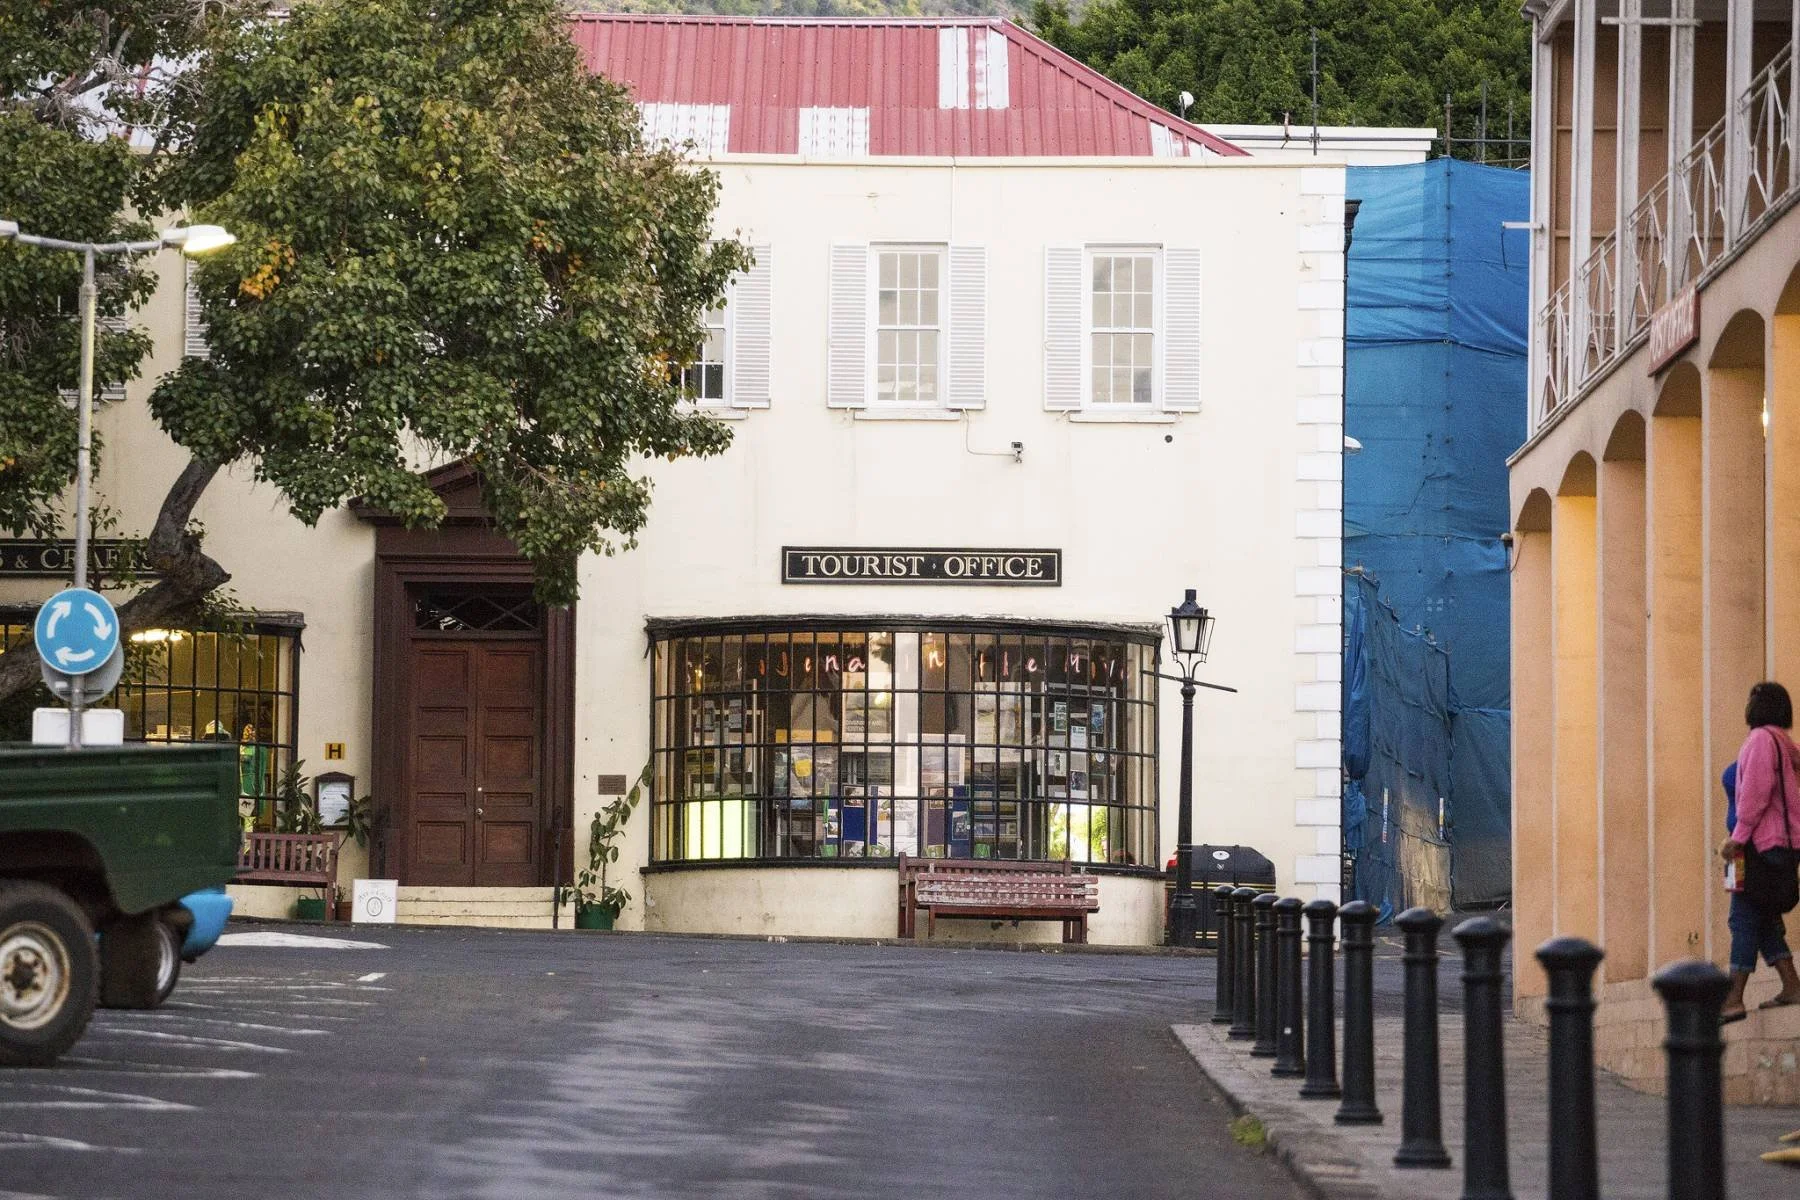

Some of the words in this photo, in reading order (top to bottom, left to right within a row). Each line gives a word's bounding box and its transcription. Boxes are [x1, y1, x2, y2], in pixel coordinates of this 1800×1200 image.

[15, 554, 29, 569] &
[802, 555, 925, 577] TOURIST
[943, 556, 1044, 578] OFFICE
[328, 744, 342, 759] H
